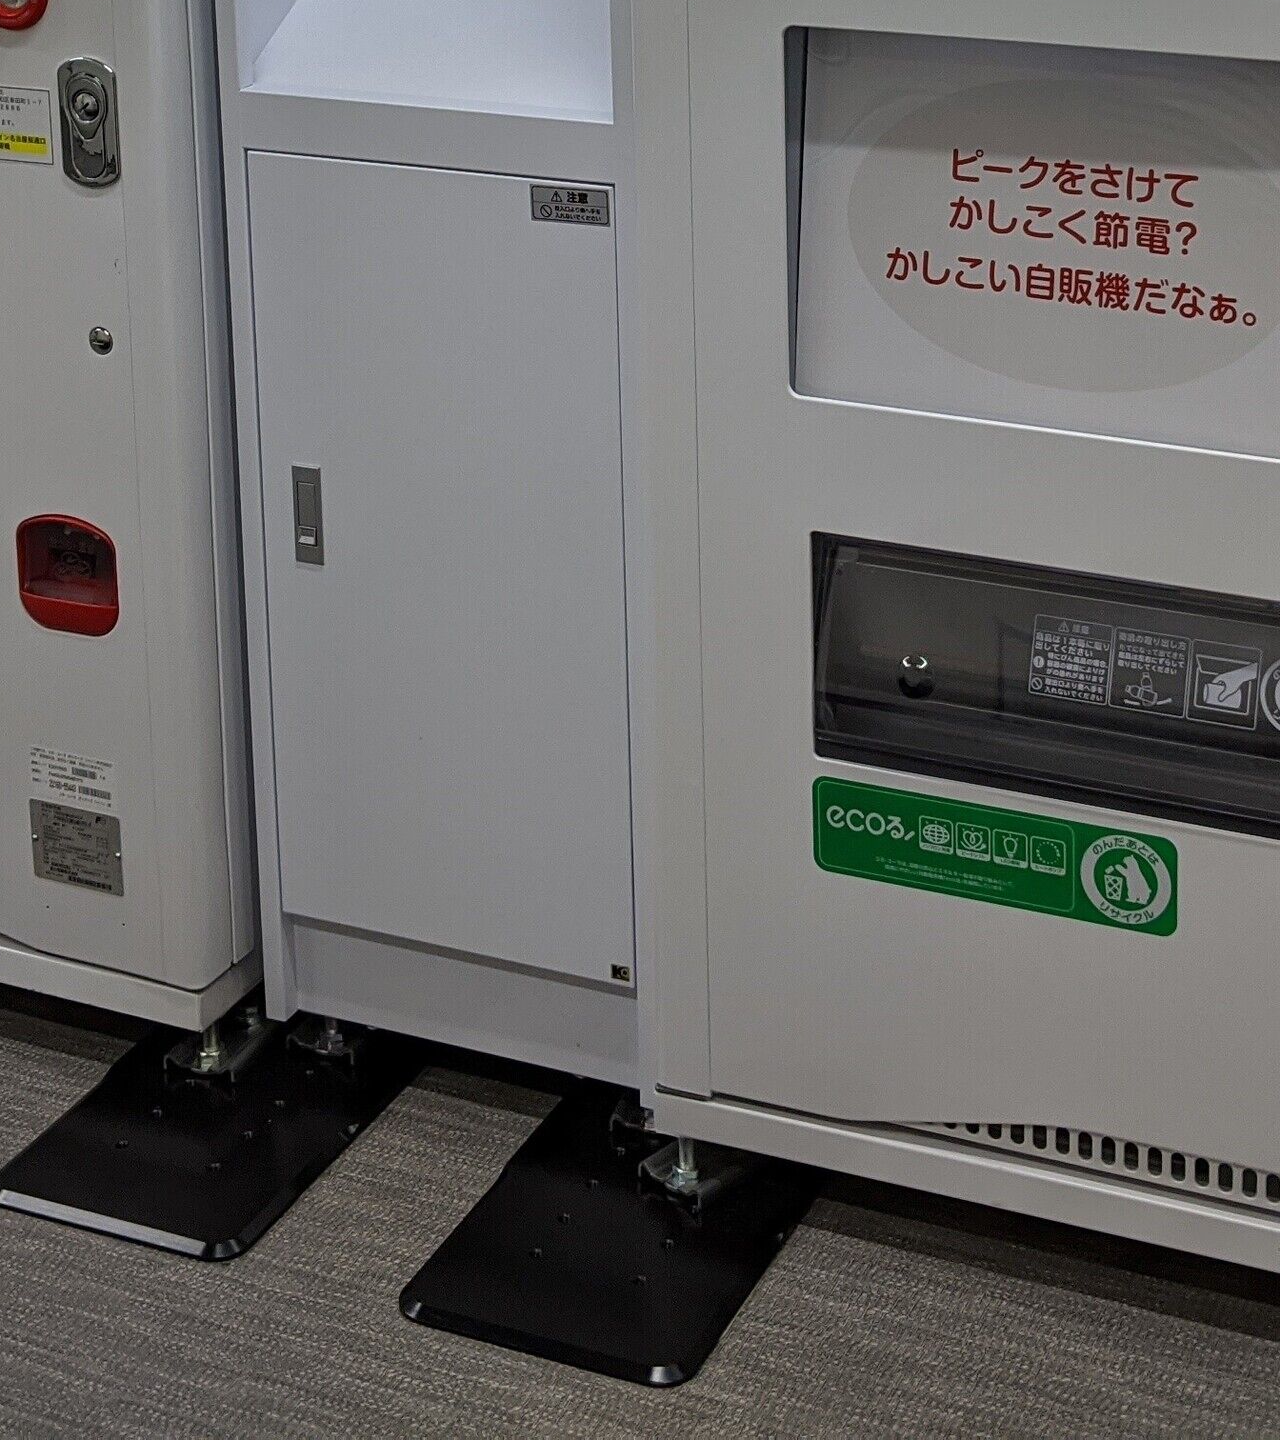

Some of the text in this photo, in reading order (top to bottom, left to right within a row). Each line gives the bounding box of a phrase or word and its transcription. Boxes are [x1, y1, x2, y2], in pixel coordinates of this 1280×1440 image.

[951, 148, 1198, 208] ピークをさけて
[885, 247, 1257, 327] かしこい自販機だなぁ。
[1091, 835, 1160, 865] のんだあとは
[1099, 900, 1155, 924] リサイクル
